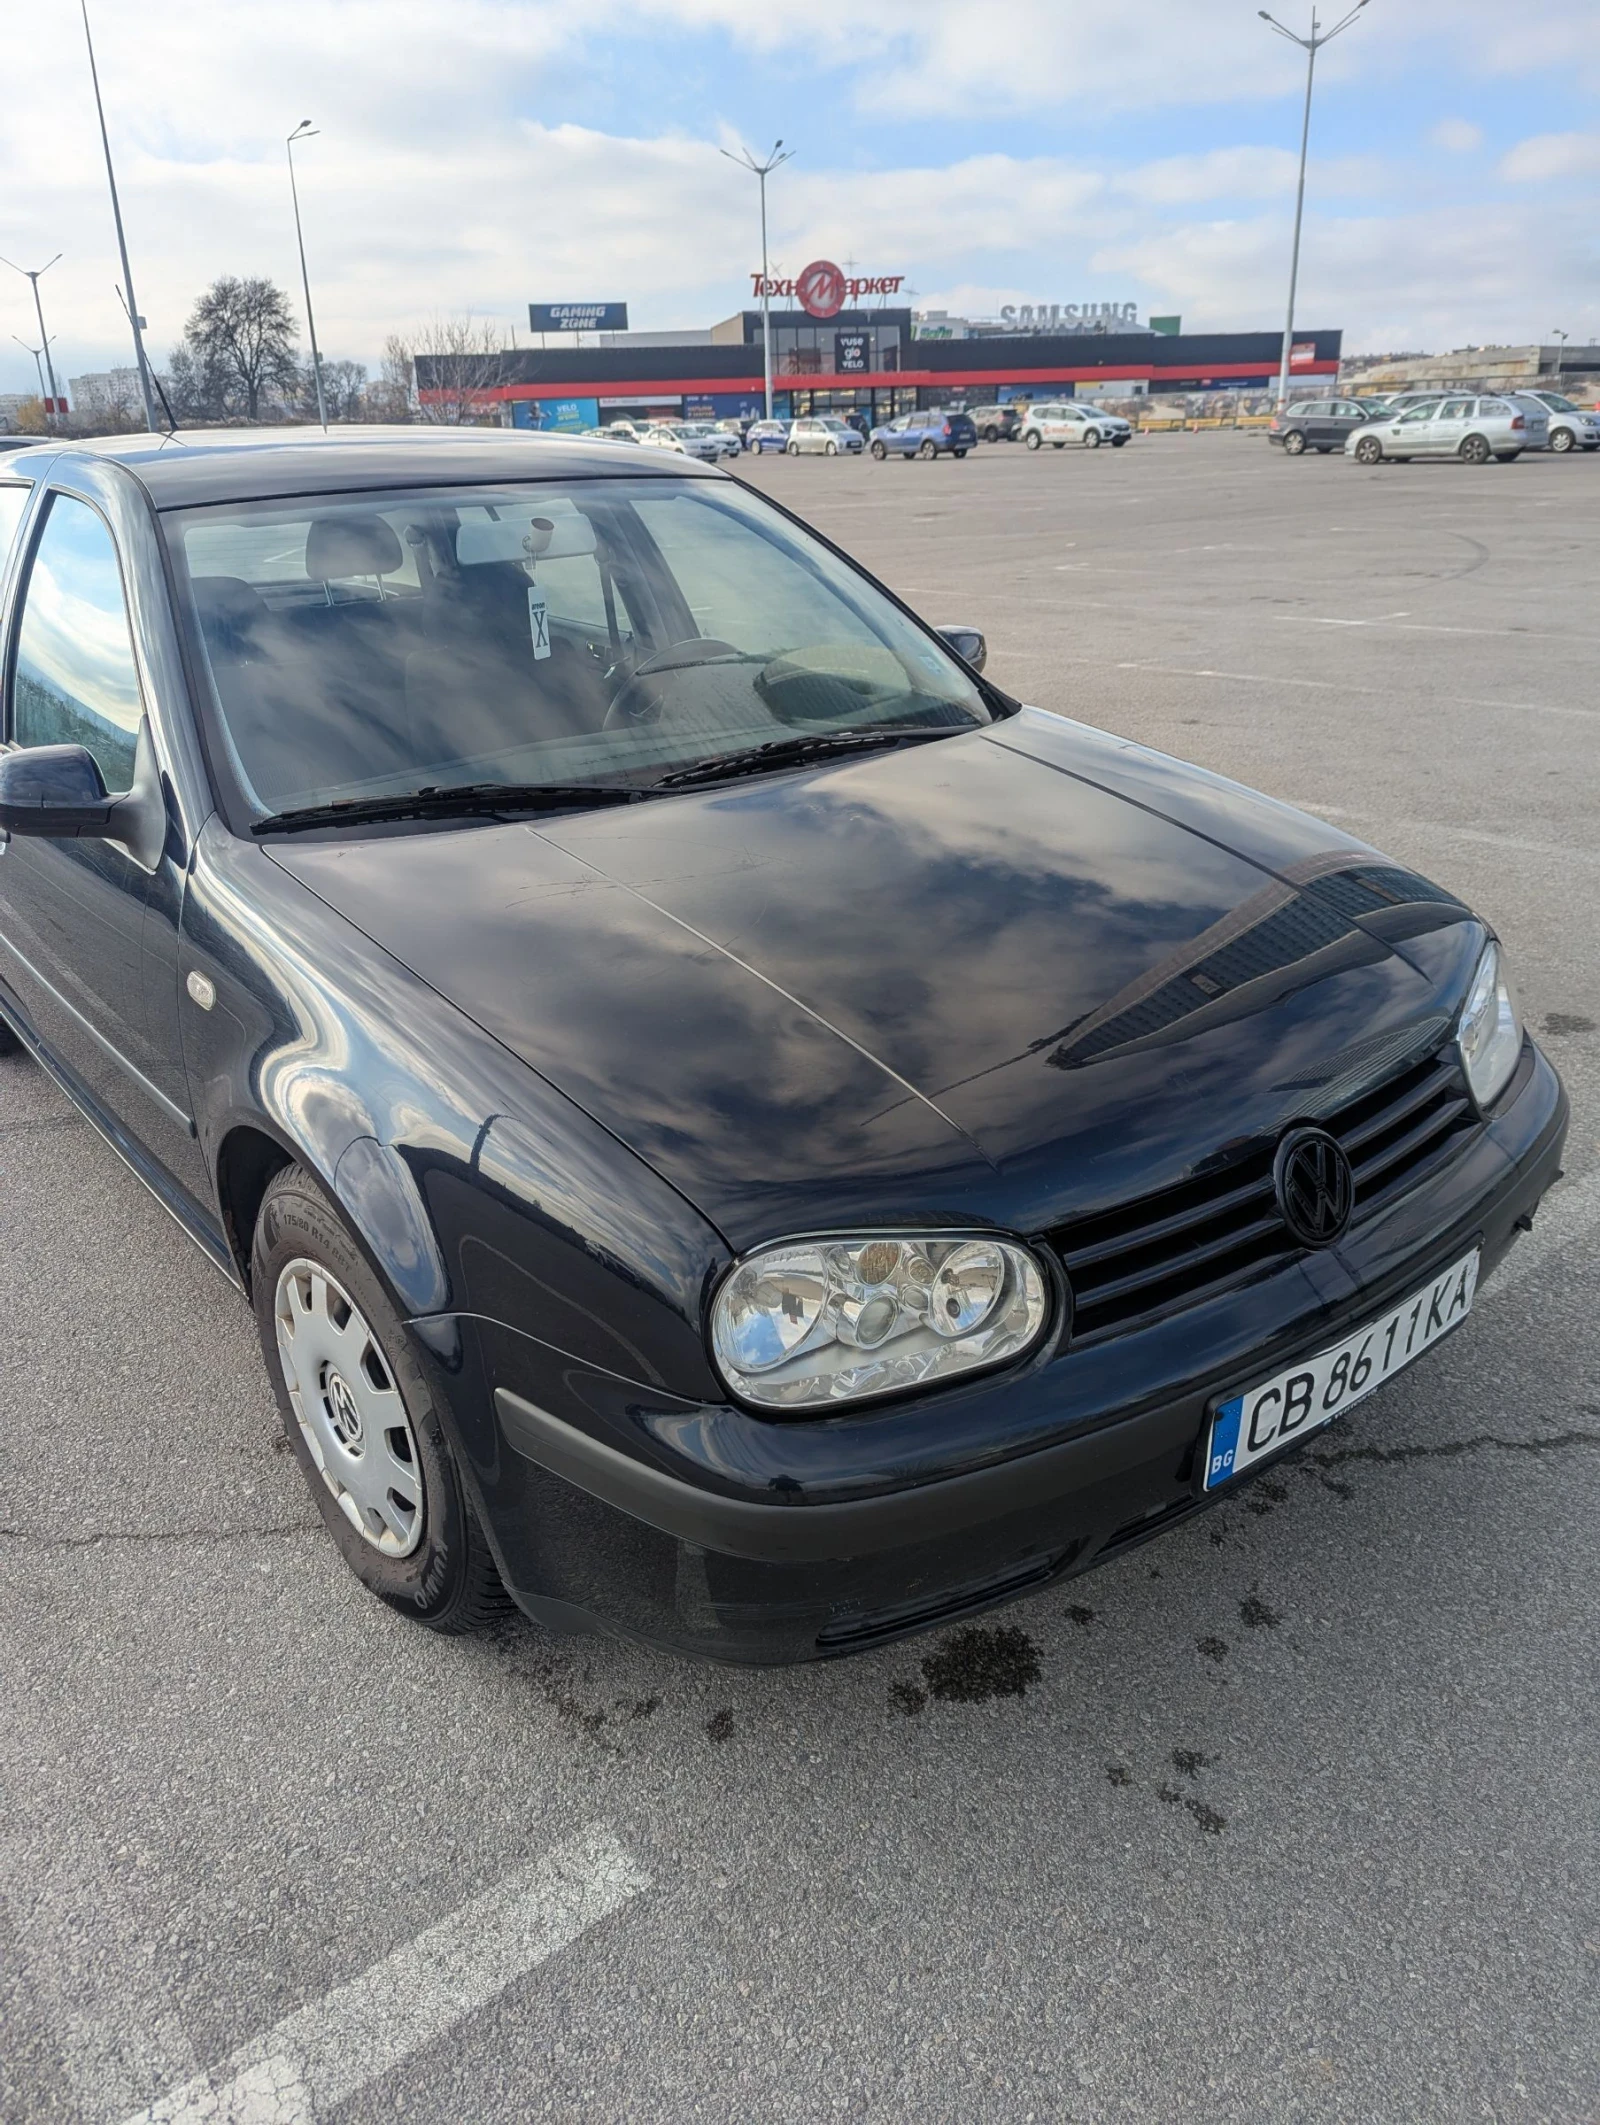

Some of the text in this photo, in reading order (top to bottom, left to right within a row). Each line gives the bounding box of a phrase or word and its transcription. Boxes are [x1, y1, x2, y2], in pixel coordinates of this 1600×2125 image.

[550, 306, 606, 318] GAMING
[560, 318, 597, 329] ZONE
[1000, 302, 1138, 331] SAMSUNG
[844, 347, 861, 360] glo
[532, 610, 548, 648] X
[1247, 1372, 1315, 1453] CB
[1322, 1298, 1423, 1411] 8611
[1211, 1449, 1234, 1474] BG
